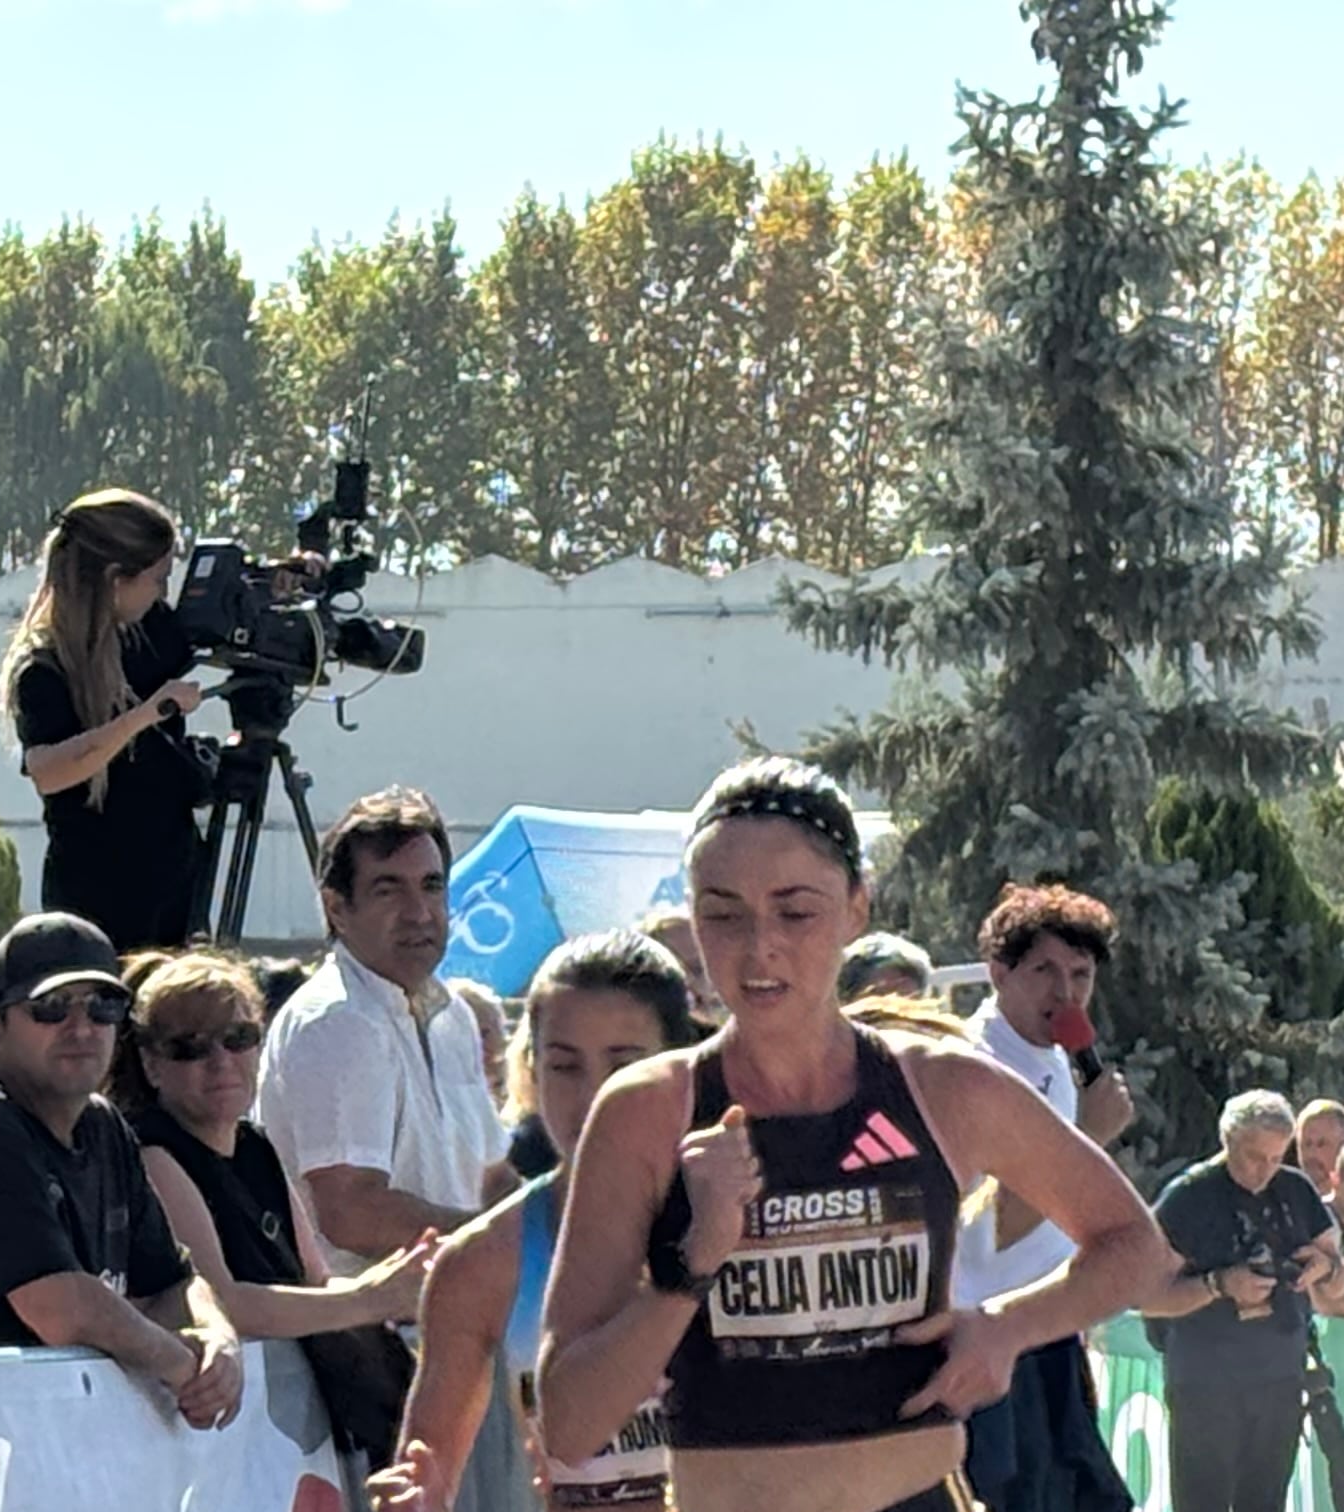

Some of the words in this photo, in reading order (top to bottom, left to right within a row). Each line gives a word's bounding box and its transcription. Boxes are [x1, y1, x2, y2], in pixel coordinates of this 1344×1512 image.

[764, 1189, 865, 1224] CROSS
[719, 1254, 809, 1318] CELIA
[819, 1234, 919, 1311] ANTÓN
